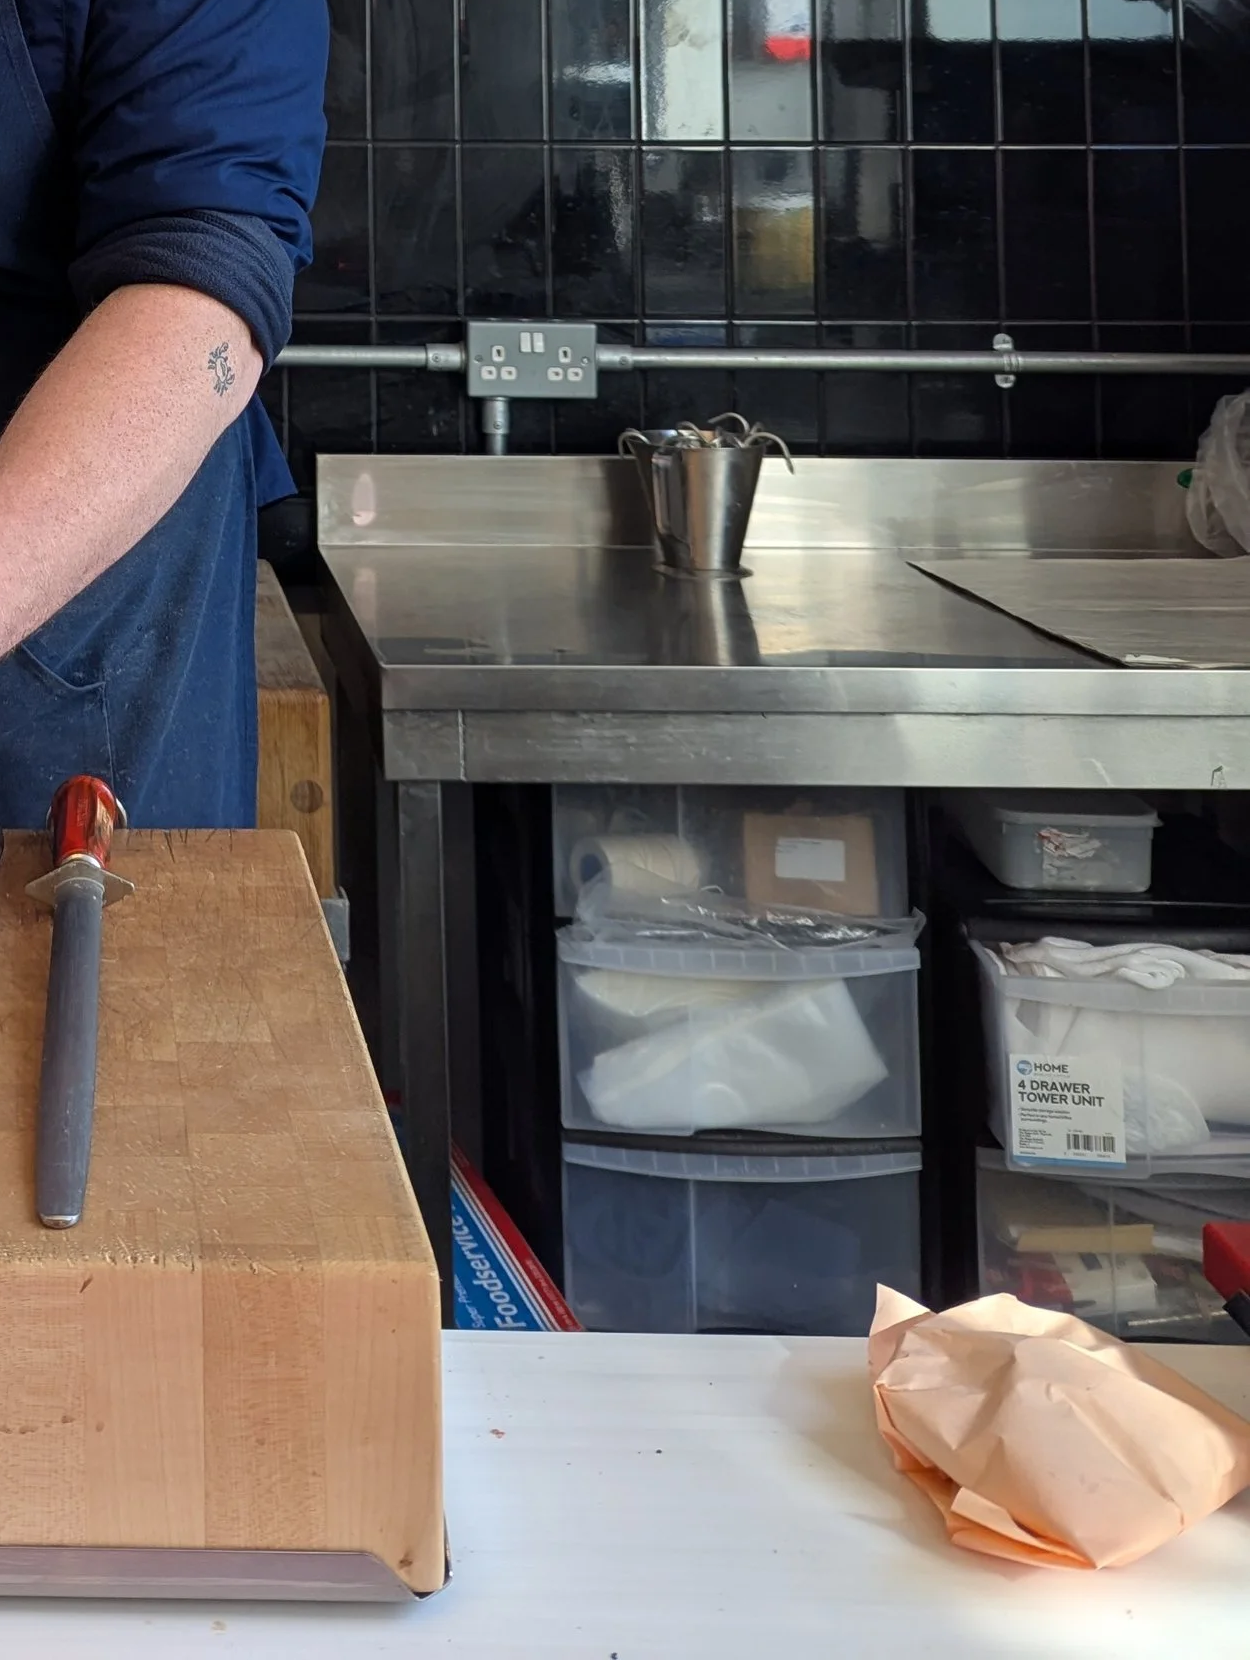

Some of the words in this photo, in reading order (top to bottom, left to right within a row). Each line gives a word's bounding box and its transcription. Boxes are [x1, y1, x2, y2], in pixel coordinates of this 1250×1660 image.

[1034, 1063, 1069, 1073] HOME
[1018, 1080, 1026, 1090] 4
[1030, 1080, 1090, 1094] DRAWER
[1018, 1091, 1068, 1104] TOWER
[1071, 1096, 1104, 1107] UNIT
